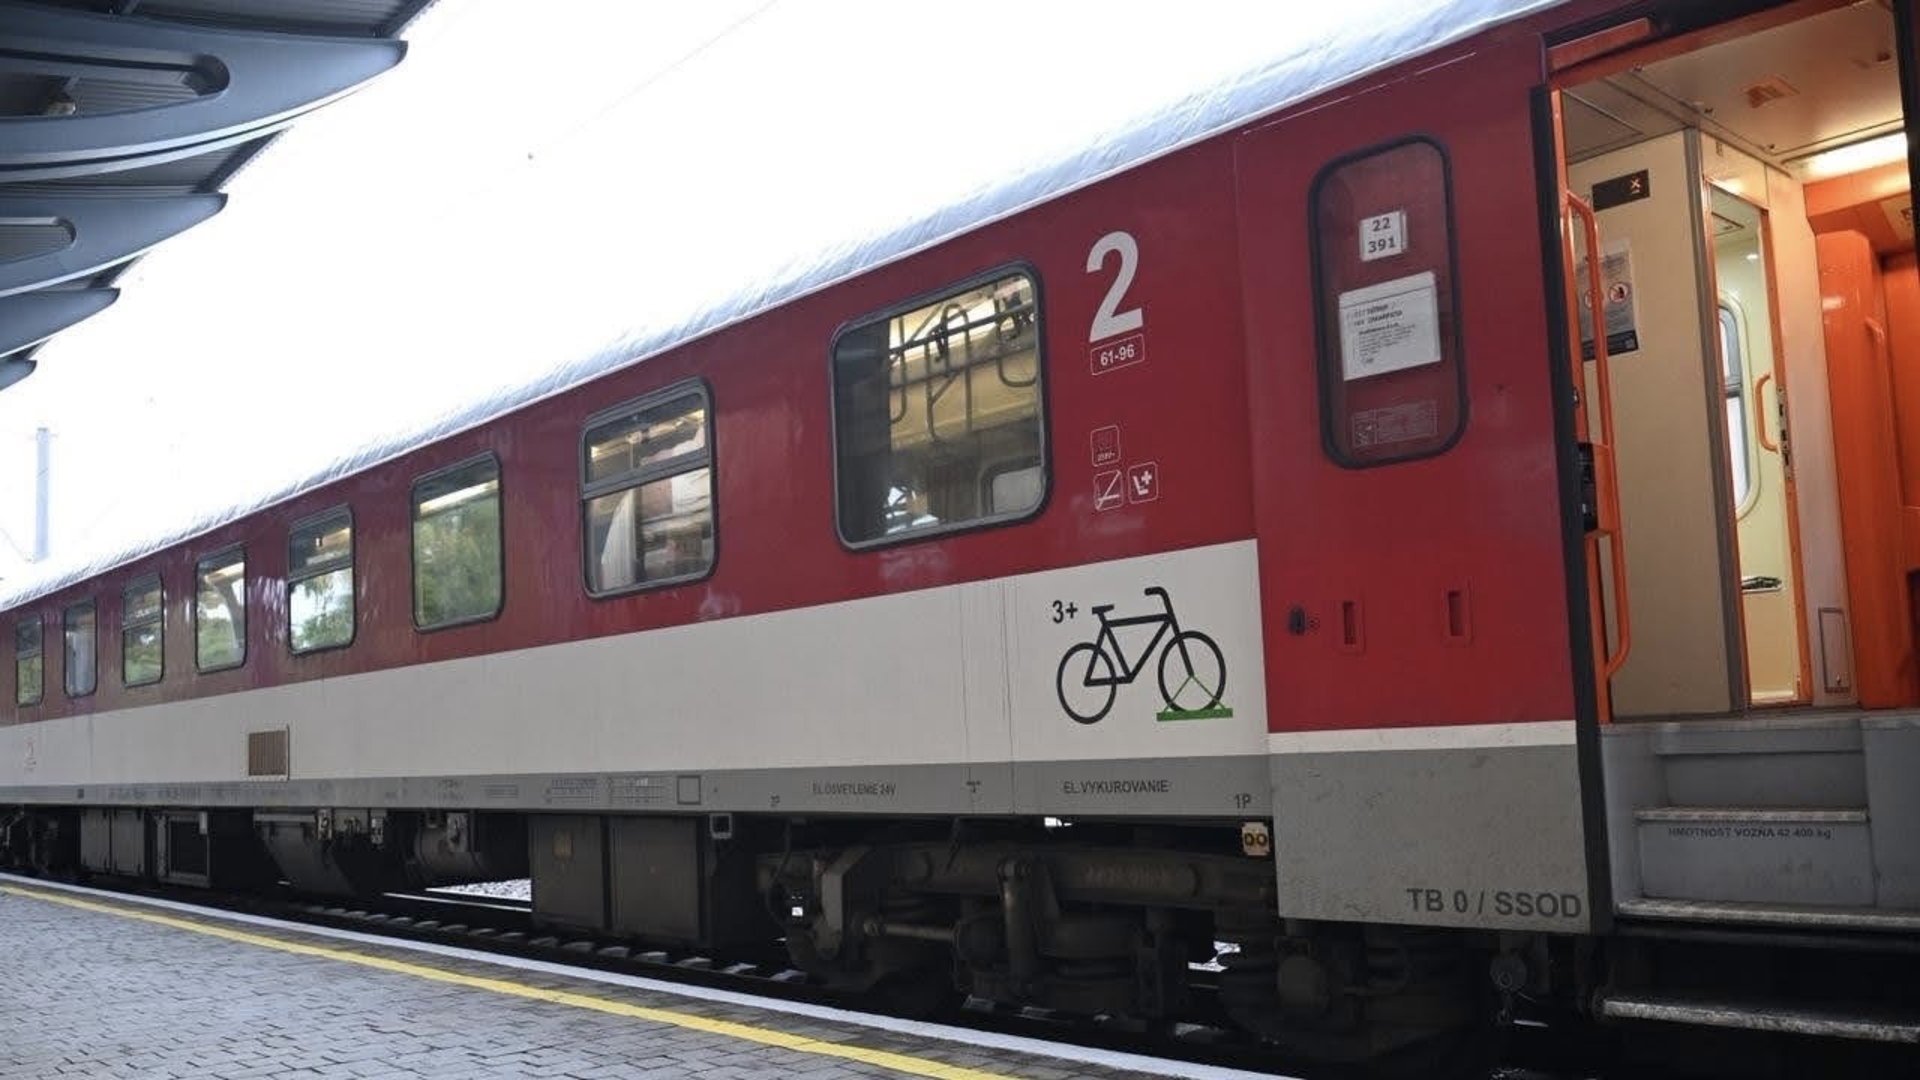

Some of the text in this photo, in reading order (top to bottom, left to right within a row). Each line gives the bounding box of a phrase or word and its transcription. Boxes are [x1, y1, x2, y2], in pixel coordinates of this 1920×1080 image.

[1372, 217, 1391, 231] 22
[1367, 236, 1396, 253] 391
[1086, 231, 1143, 342] 2
[1100, 344, 1135, 366] 61-96
[1052, 600, 1078, 623] 3+
[1233, 793, 1252, 809] 1P
[1777, 827, 1791, 838] 42
[1793, 827, 1814, 838] 400
[1816, 827, 1832, 840] kg
[1406, 888, 1444, 912] TB
[1477, 890, 1486, 915] /
[1494, 891, 1582, 918] SSOD
